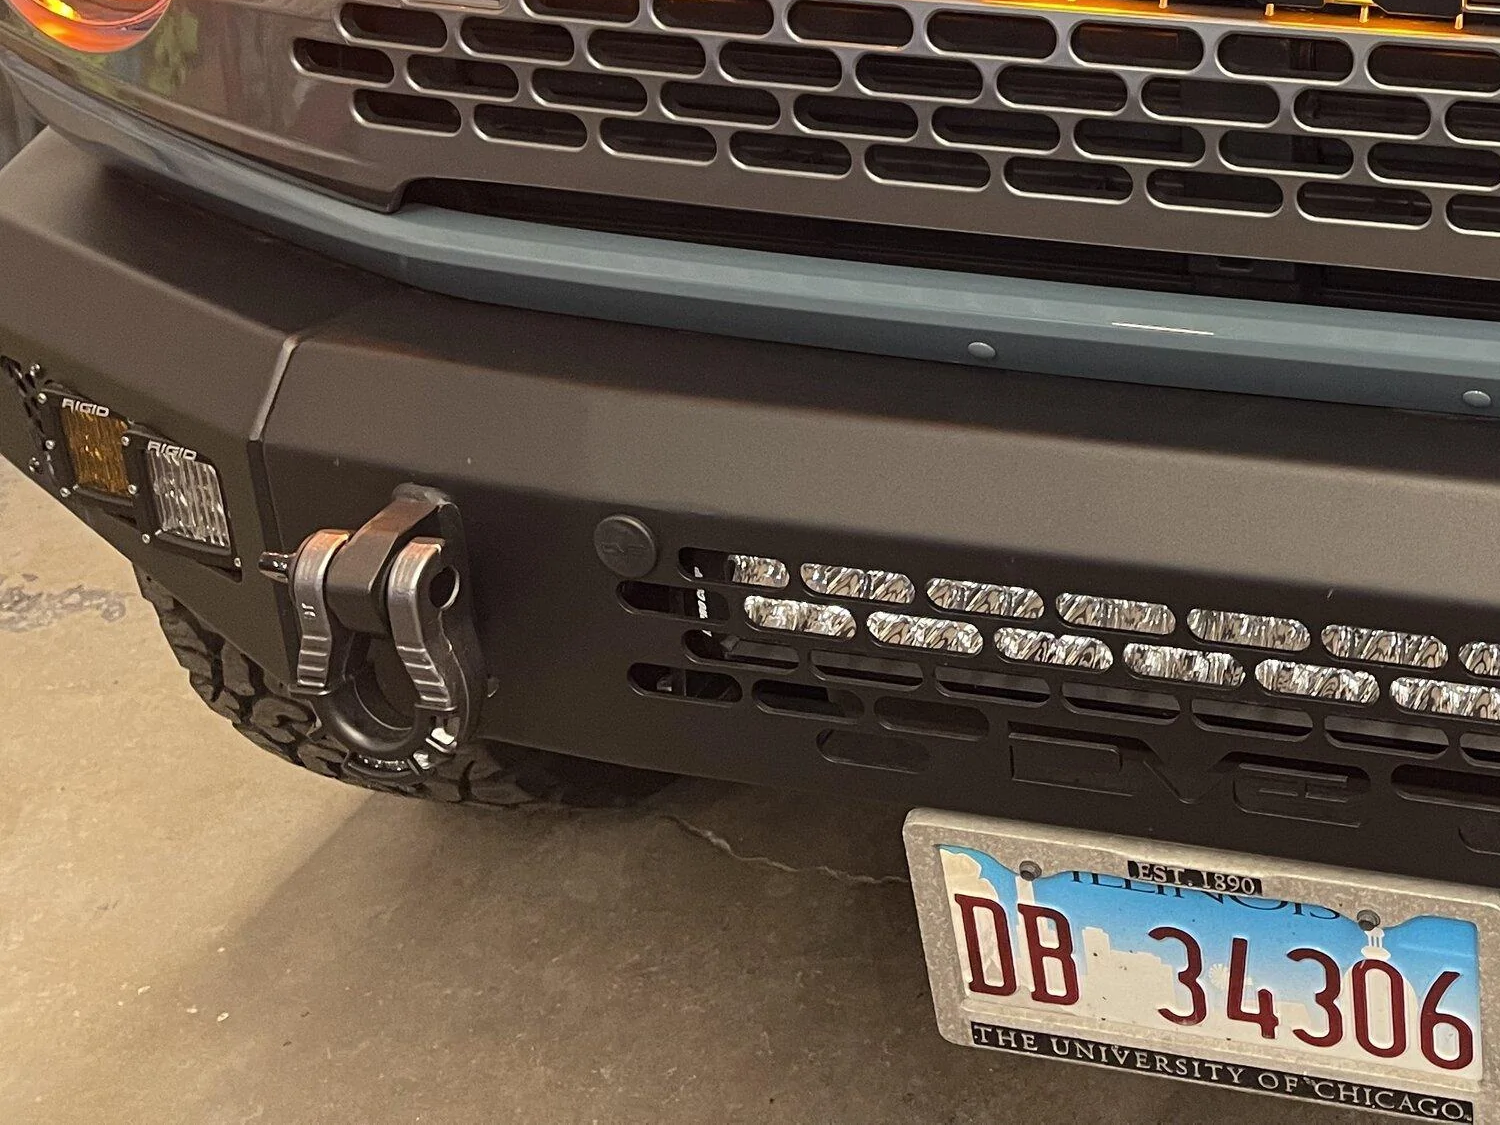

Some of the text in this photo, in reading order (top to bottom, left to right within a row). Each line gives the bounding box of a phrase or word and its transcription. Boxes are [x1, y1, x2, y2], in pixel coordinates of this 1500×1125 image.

[61, 398, 110, 418] RIGID
[147, 440, 198, 461] RIGID
[1137, 861, 1194, 887] EST.
[1202, 873, 1256, 896] 1890
[954, 894, 1080, 1006] DB
[1148, 926, 1474, 1070] 34306
[974, 1025, 1465, 1121] THE UNIVERSITY OF CHICAGO
